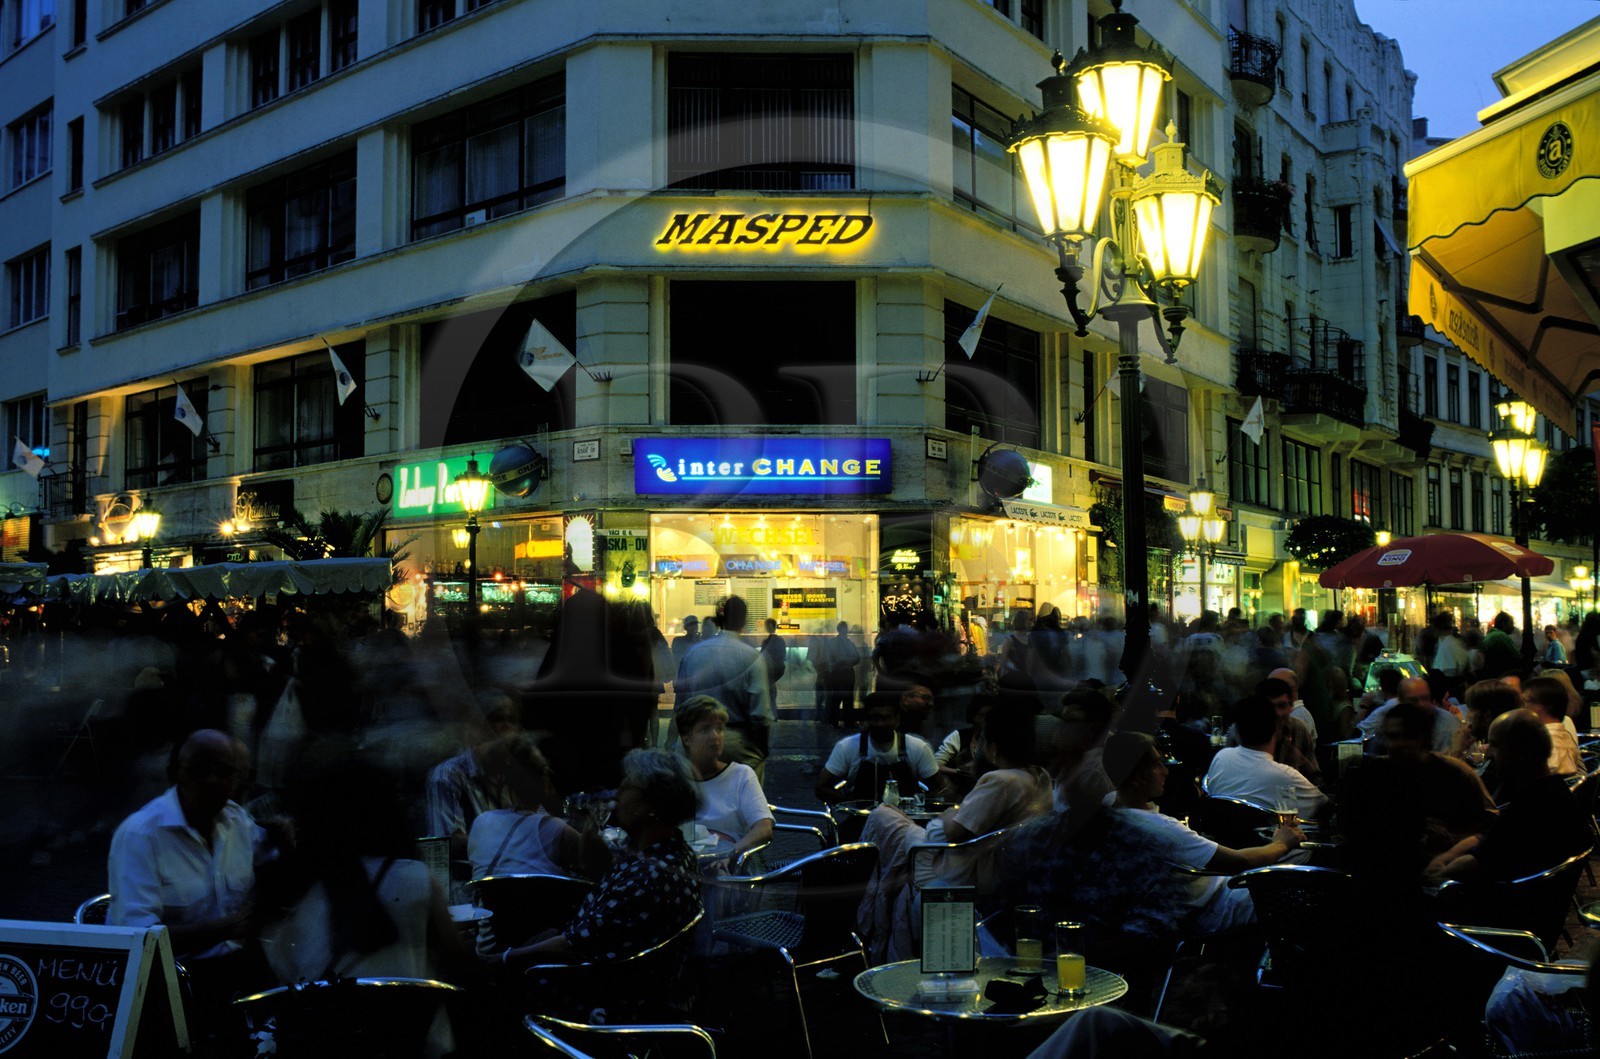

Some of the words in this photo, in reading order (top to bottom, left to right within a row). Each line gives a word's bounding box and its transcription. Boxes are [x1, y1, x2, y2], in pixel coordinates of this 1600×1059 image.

[655, 213, 874, 246] MASPED
[678, 459, 745, 477] inter
[752, 459, 882, 476] CHANGE
[1010, 506, 1029, 517] LACOSTE
[715, 528, 817, 546] WECHSEL
[658, 561, 710, 572] WECHSEL
[725, 560, 782, 571] CHANGE
[798, 561, 848, 573] WECHSEL
[11, 965, 28, 986] BEER
[37, 958, 119, 987] MENÜ
